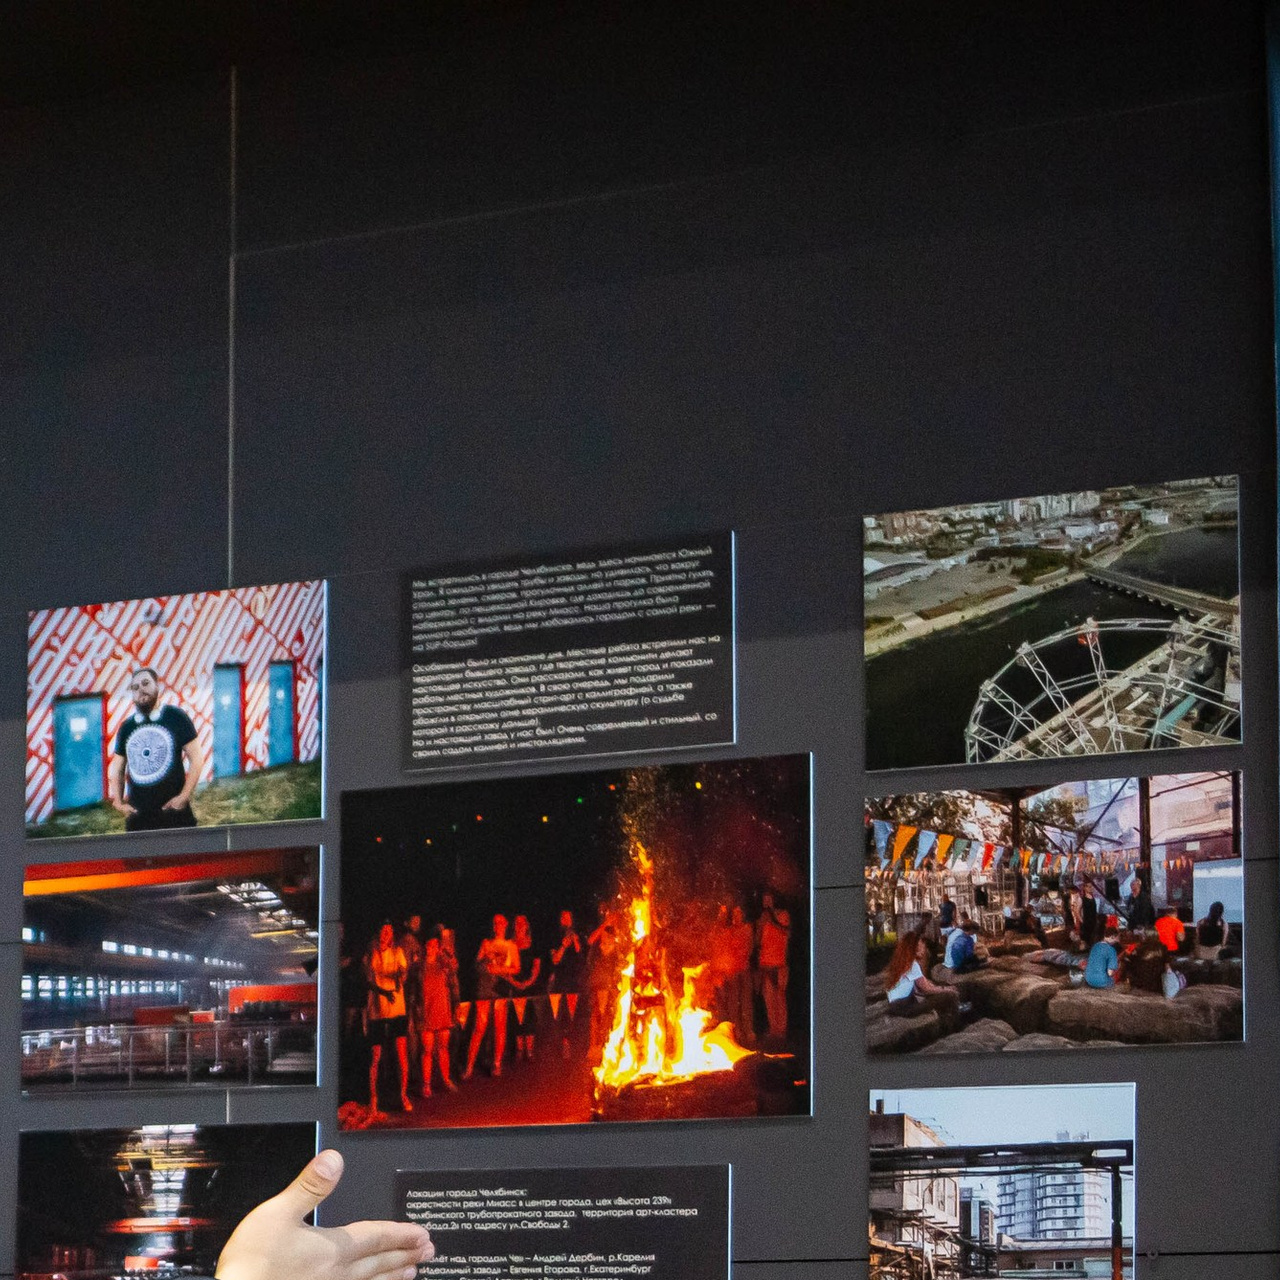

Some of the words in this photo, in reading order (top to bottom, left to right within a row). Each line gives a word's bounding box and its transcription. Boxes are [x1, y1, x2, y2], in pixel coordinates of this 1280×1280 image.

[406, 1189, 444, 1199] Локации
[446, 1190, 477, 1198] города
[478, 1188, 527, 1197] Челябинск:
[406, 1200, 461, 1209] окрестности
[462, 1200, 484, 1208] реки
[486, 1198, 516, 1207] Миасс
[525, 1199, 556, 1207] центре
[558, 1198, 593, 1207] города,
[595, 1198, 611, 1206] цех
[613, 1196, 650, 1205] «Высота
[406, 1210, 465, 1219] Челябинского
[467, 1209, 541, 1219] трубопрокатного
[581, 1210, 633, 1218] территория
[635, 1209, 698, 1217] арт-кластера
[473, 1222, 506, 1231] адресу
[509, 1220, 560, 1230] ул.Свободы
[562, 1220, 570, 1229] 2.
[449, 1255, 466, 1263] над
[532, 1253, 566, 1263] Андрей
[568, 1253, 606, 1262] Дербин,
[608, 1252, 655, 1262] р.Карелия
[419, 1265, 470, 1275] «Идеальный
[472, 1267, 501, 1275] завод»
[509, 1265, 542, 1273] Евгения
[544, 1265, 582, 1274] Егорова,
[584, 1264, 651, 1274] г.Екатеринбург
